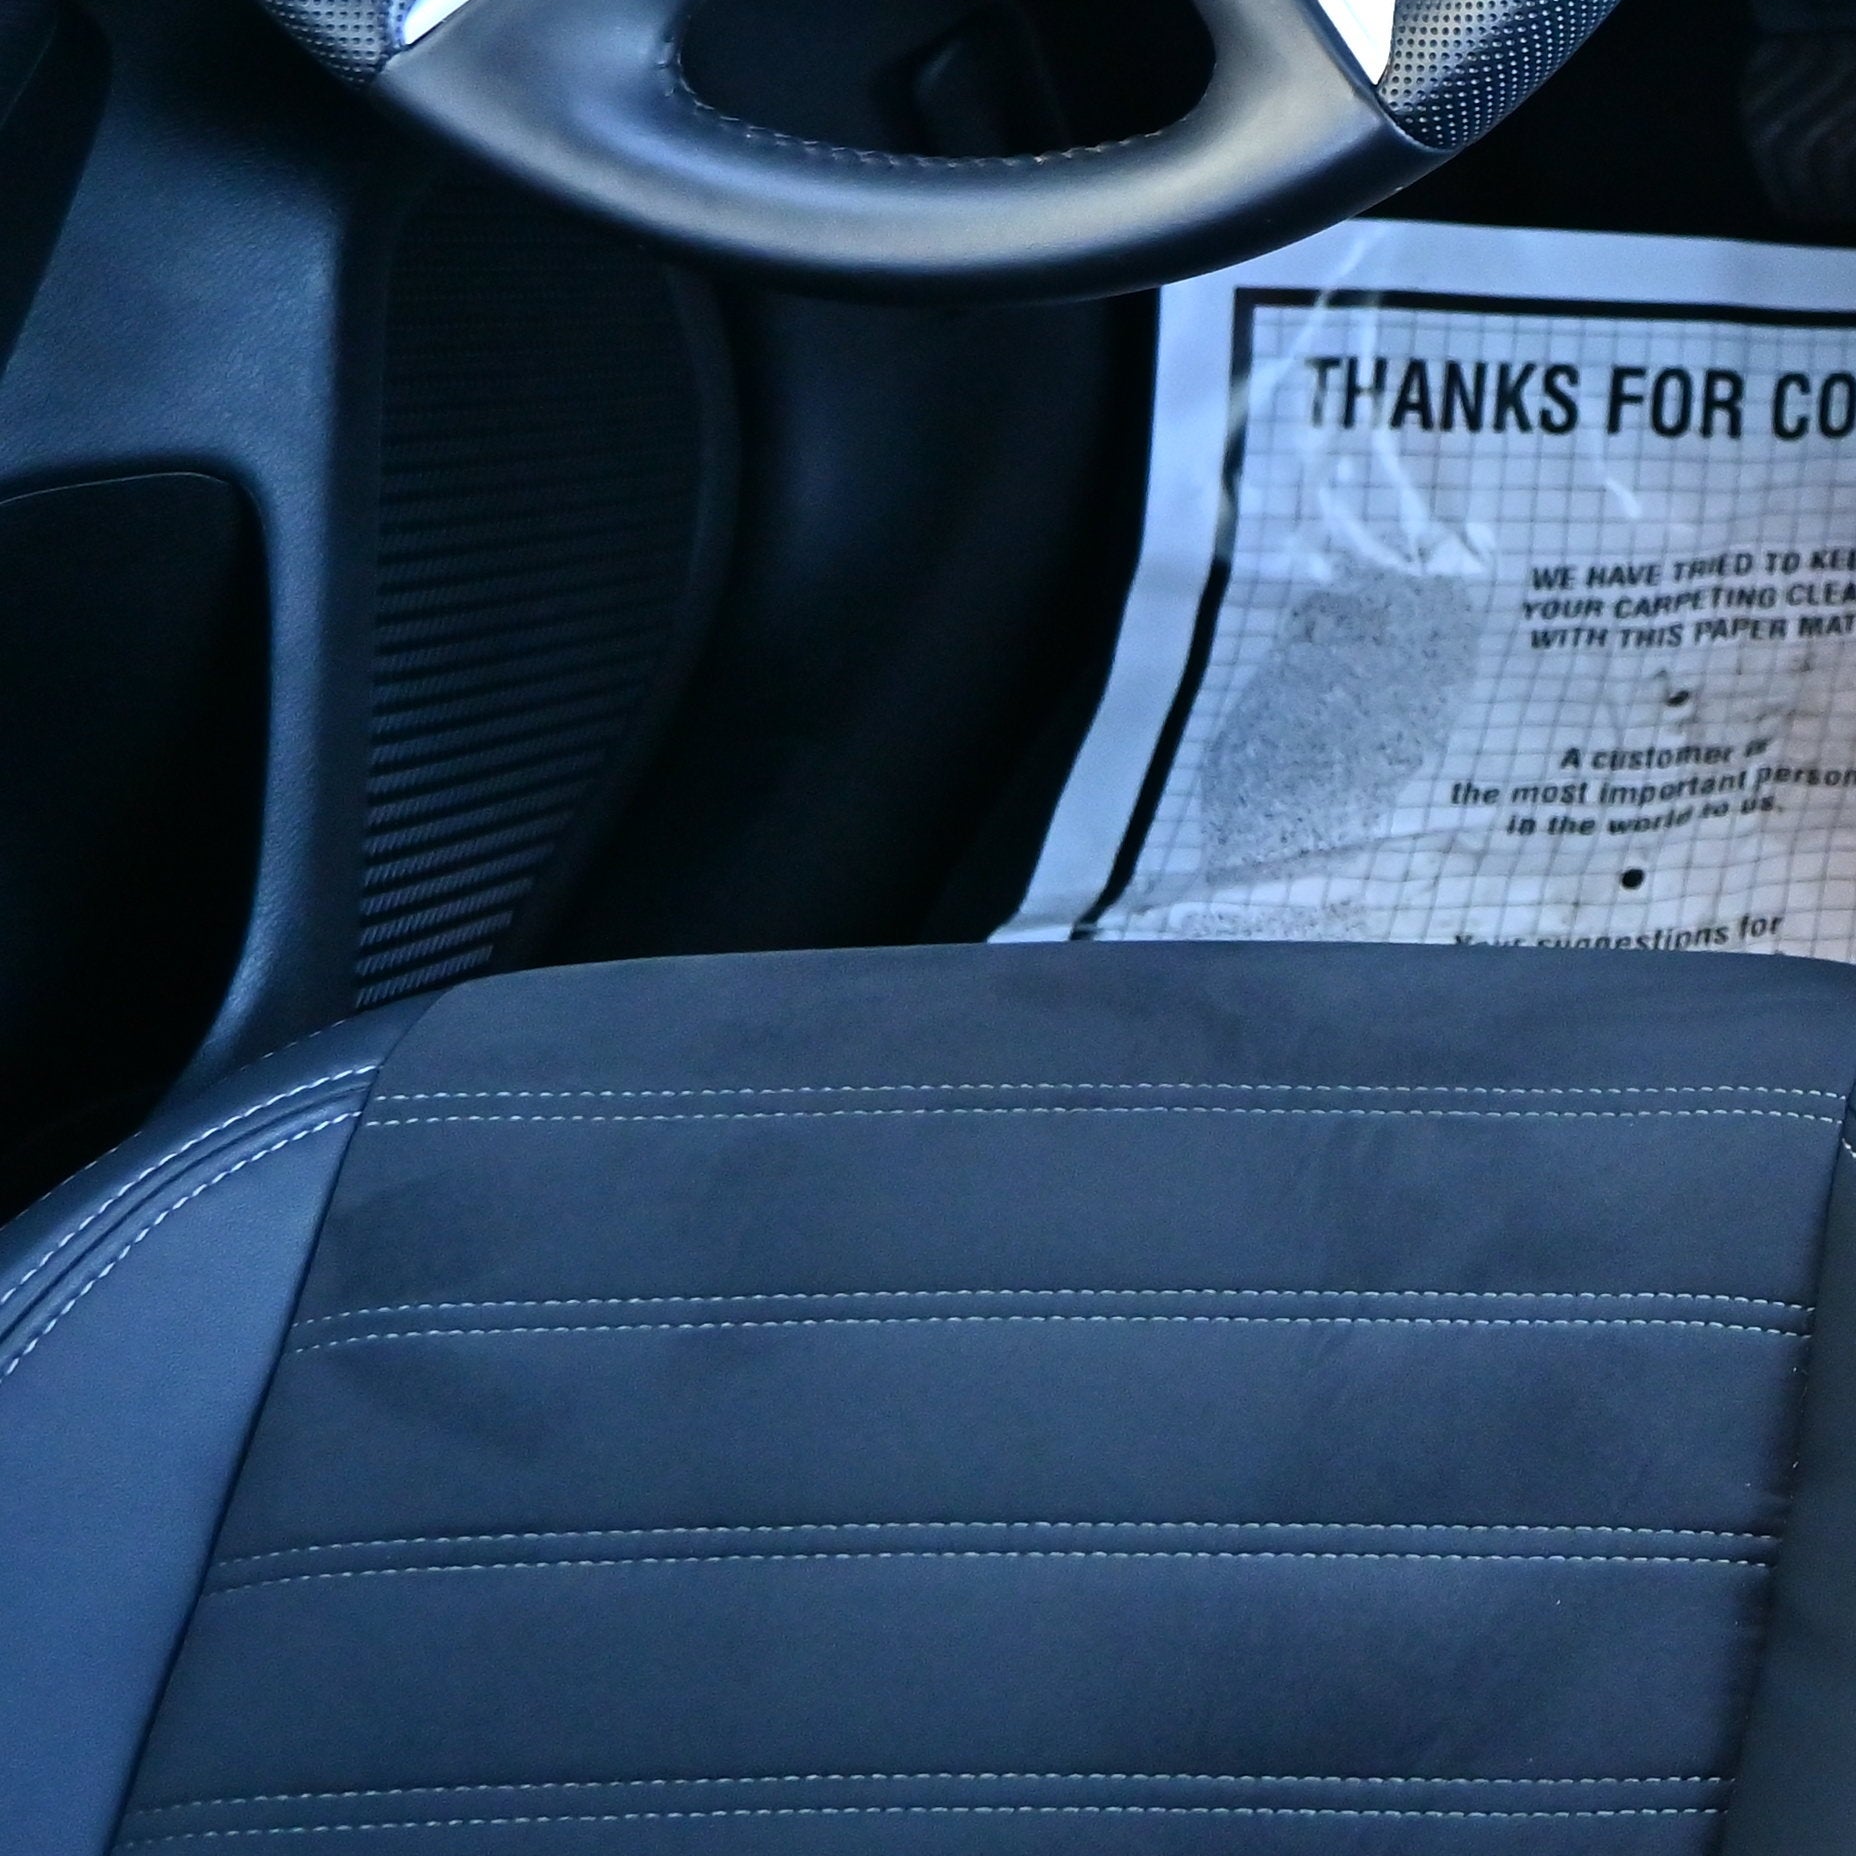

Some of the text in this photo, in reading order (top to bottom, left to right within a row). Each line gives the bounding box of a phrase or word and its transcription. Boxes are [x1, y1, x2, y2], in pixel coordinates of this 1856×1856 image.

[1304, 355, 1581, 437] THANKS
[1606, 363, 1745, 438] FOR
[1531, 566, 1576, 591] WE
[1586, 562, 1661, 589] HAVE
[1673, 553, 1753, 583] TRIED
[1765, 550, 1801, 575] TO
[1522, 595, 1602, 621] YOUR
[1612, 585, 1778, 620] CARPETING
[1529, 613, 1856, 650] WITH THIS PAPER MAT
[1560, 746, 1582, 770] A
[1591, 741, 1734, 770] customer
[1450, 782, 1499, 807] the
[1510, 782, 1589, 807] most
[1599, 769, 1749, 809] important
[1505, 812, 1537, 837] in
[1547, 811, 1596, 836] the
[1606, 804, 1692, 836] world
[1700, 798, 1729, 820] to
[1739, 914, 1784, 940] for
